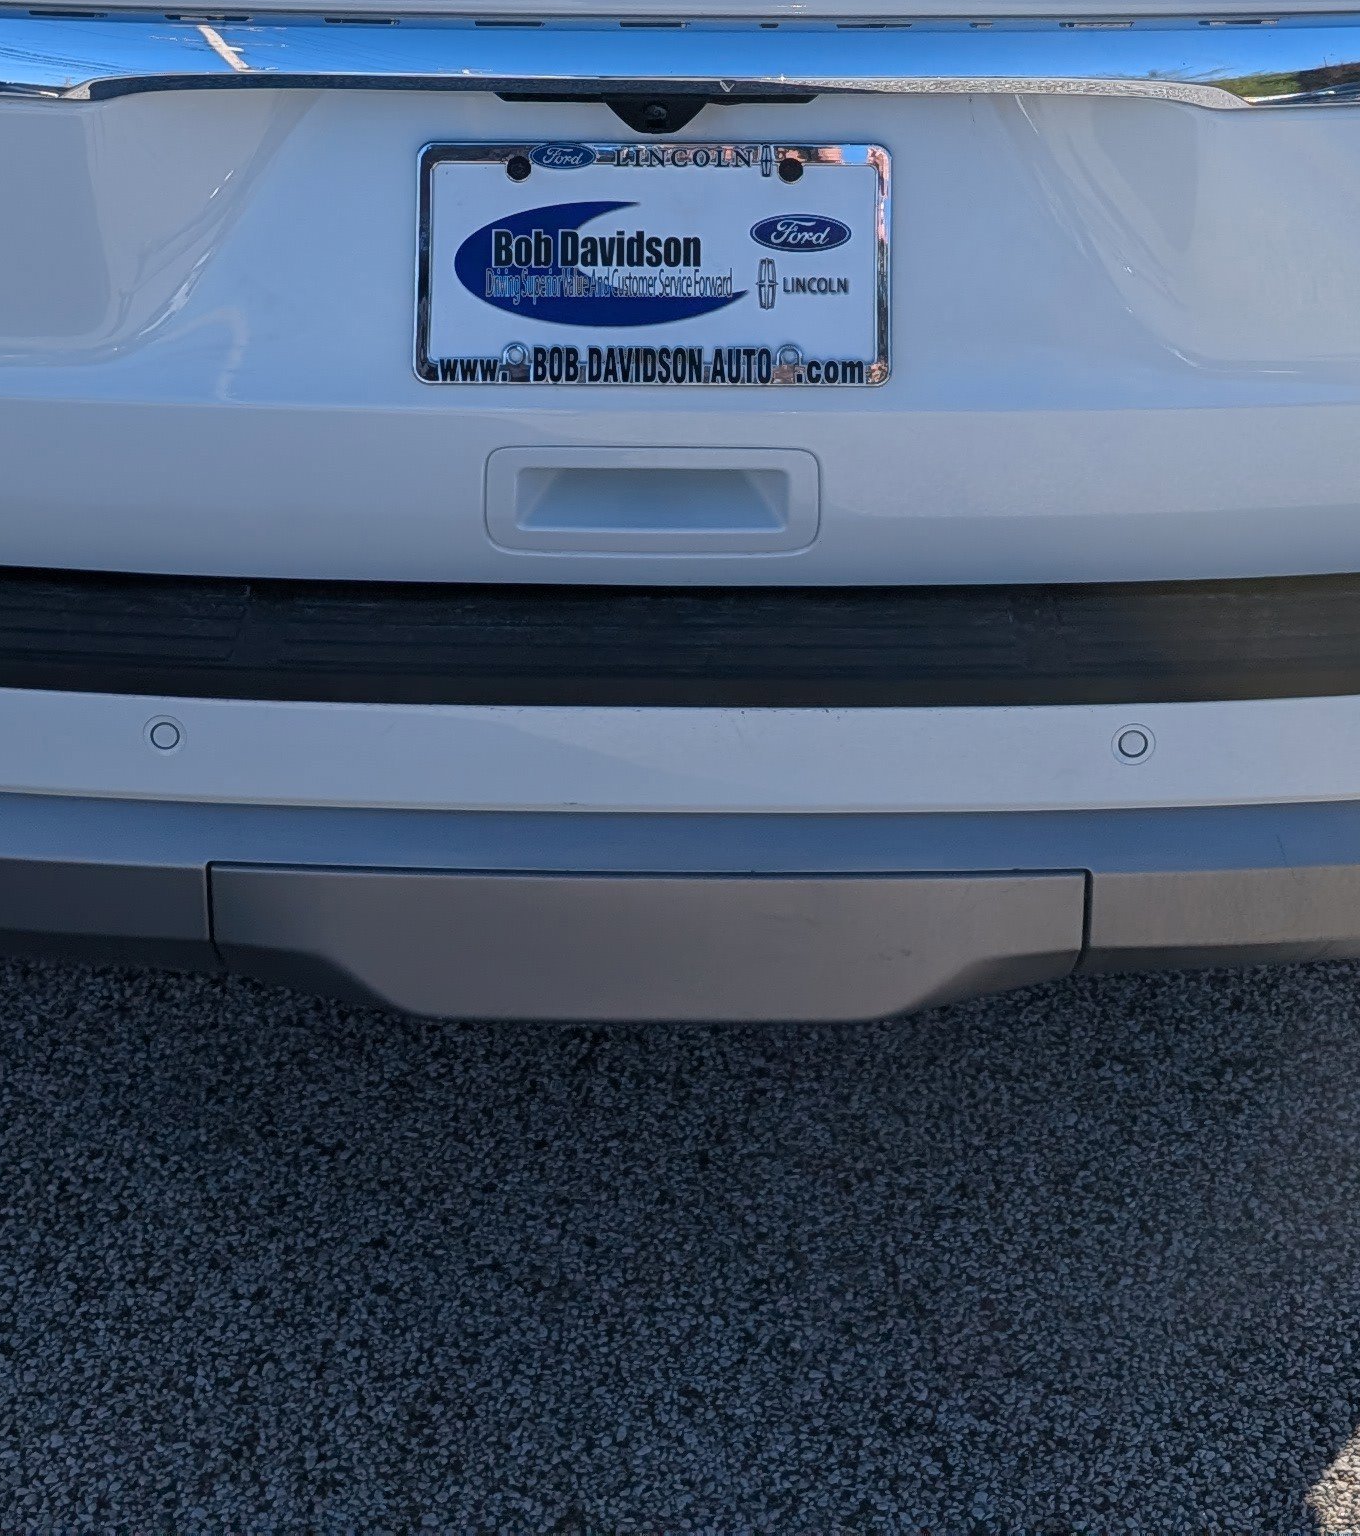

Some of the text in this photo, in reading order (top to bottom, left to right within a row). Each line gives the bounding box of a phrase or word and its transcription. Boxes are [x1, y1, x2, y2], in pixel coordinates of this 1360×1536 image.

[614, 148, 753, 168] LINCOLN
[770, 217, 831, 246] Ford
[493, 230, 702, 268] Bob Davidson
[486, 268, 520, 305] Driving
[521, 268, 563, 305] Superior
[562, 268, 589, 298] Value
[612, 268, 656, 298] Customer
[658, 268, 692, 298] Service
[694, 268, 733, 298] Forward
[782, 277, 849, 294] LINCOLN
[533, 346, 580, 383] BOB
[588, 346, 703, 384] DAVIDSON
[711, 347, 772, 384] AUTO
